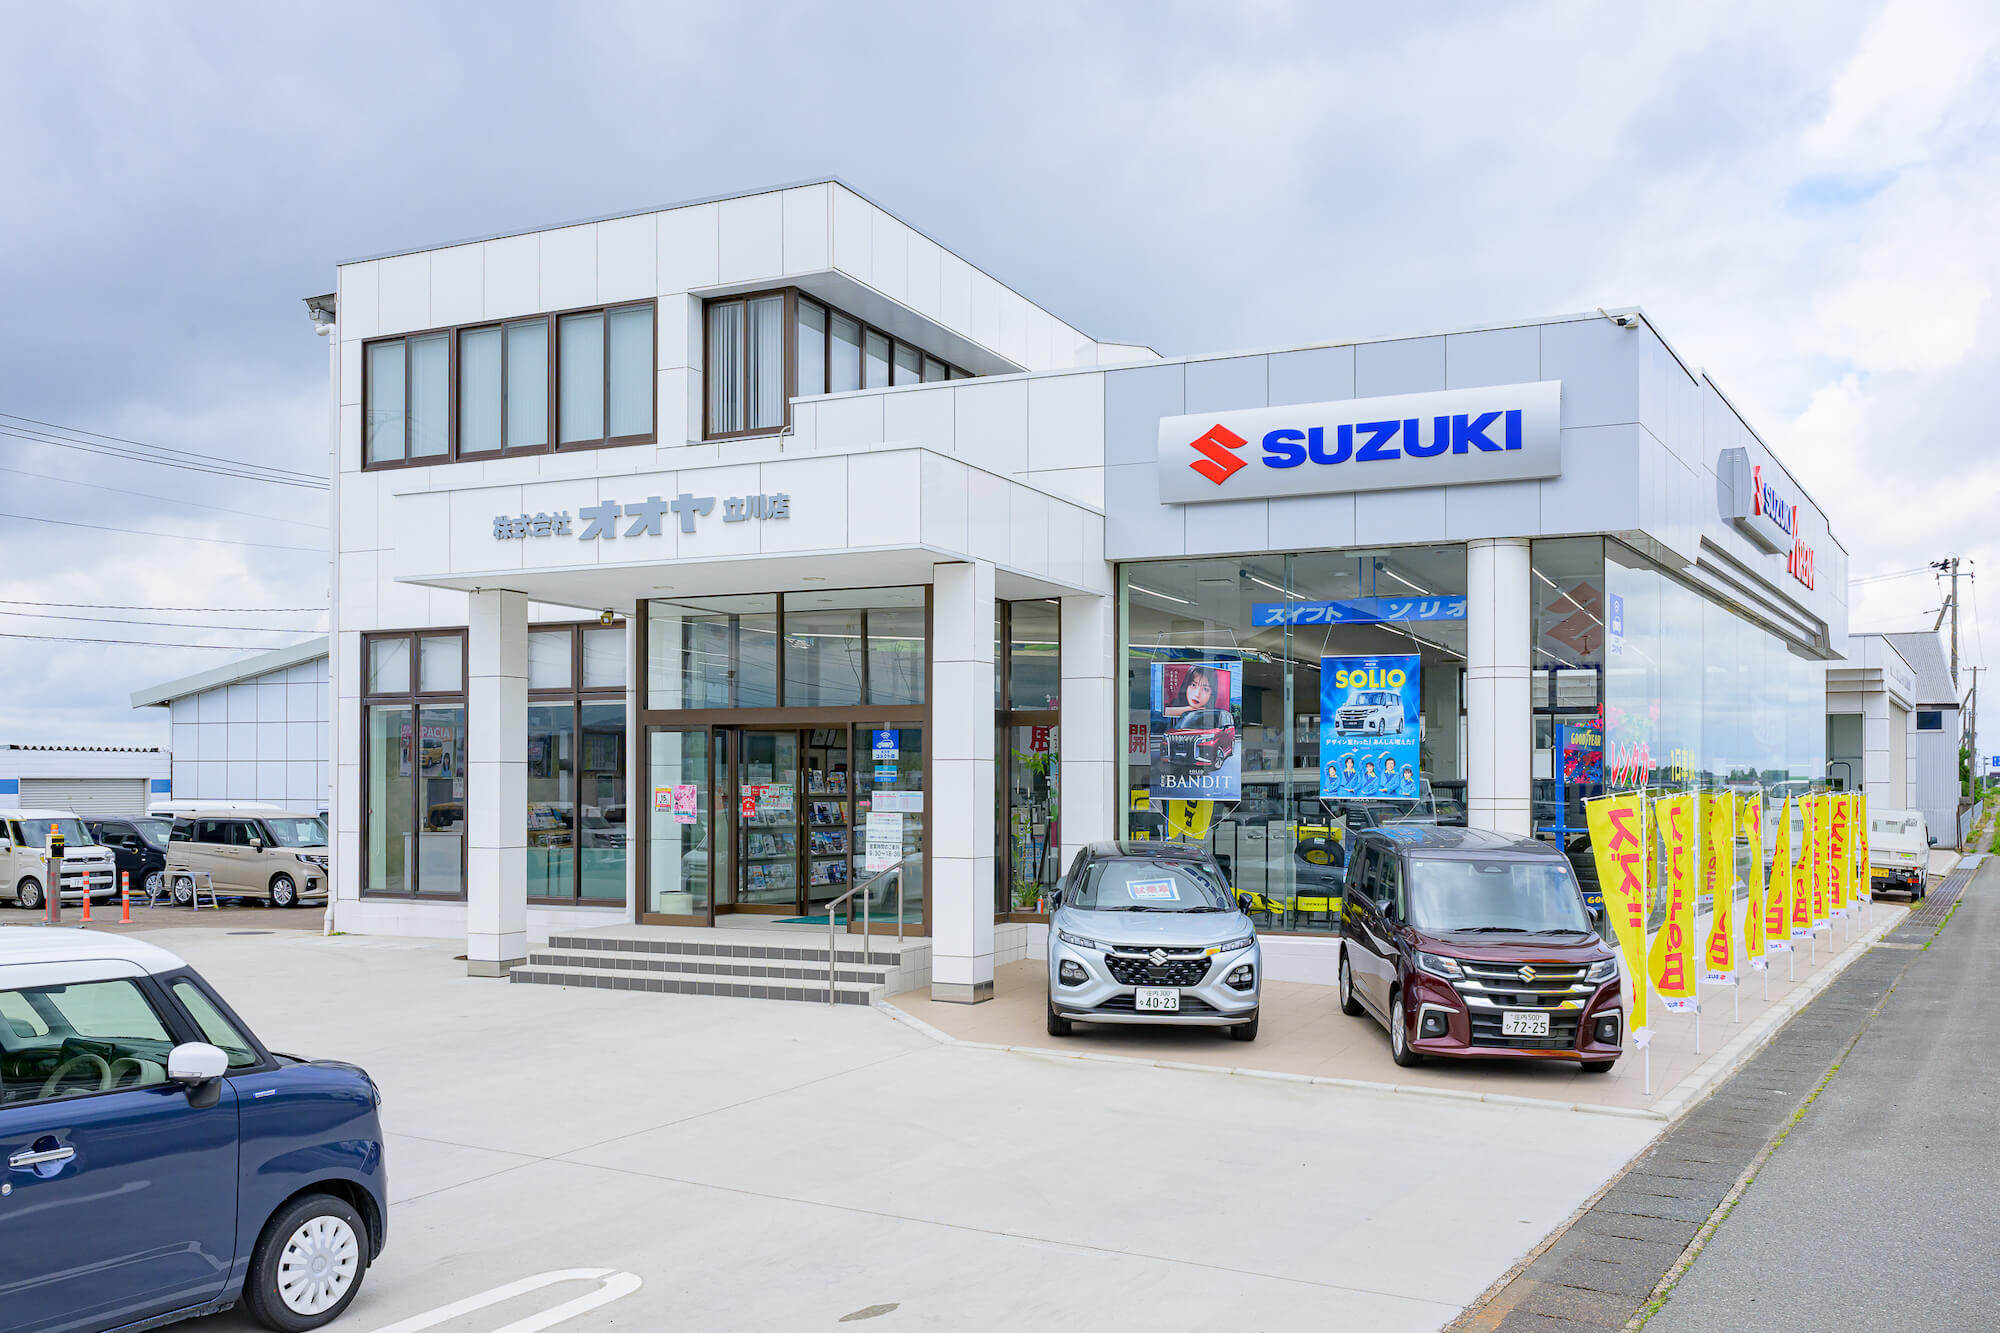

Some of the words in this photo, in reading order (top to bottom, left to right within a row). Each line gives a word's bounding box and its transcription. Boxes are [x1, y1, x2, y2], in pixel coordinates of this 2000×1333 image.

[1262, 409, 1522, 469] SUZUKI
[492, 510, 573, 540] 株式会社
[578, 493, 716, 540] オオヤ
[723, 492, 791, 523] 立川店
[1265, 606, 1343, 625] スイフト
[1389, 601, 1466, 620] ソリオ
[1335, 669, 1406, 688] SOLIO
[421, 726, 451, 738] PACIA
[1129, 724, 1148, 754] 開
[1611, 741, 1656, 788] レンタカー
[1167, 775, 1232, 789] BANDIT
[1145, 997, 1177, 1008] 40-23
[1513, 1021, 1546, 1034] 72-25
